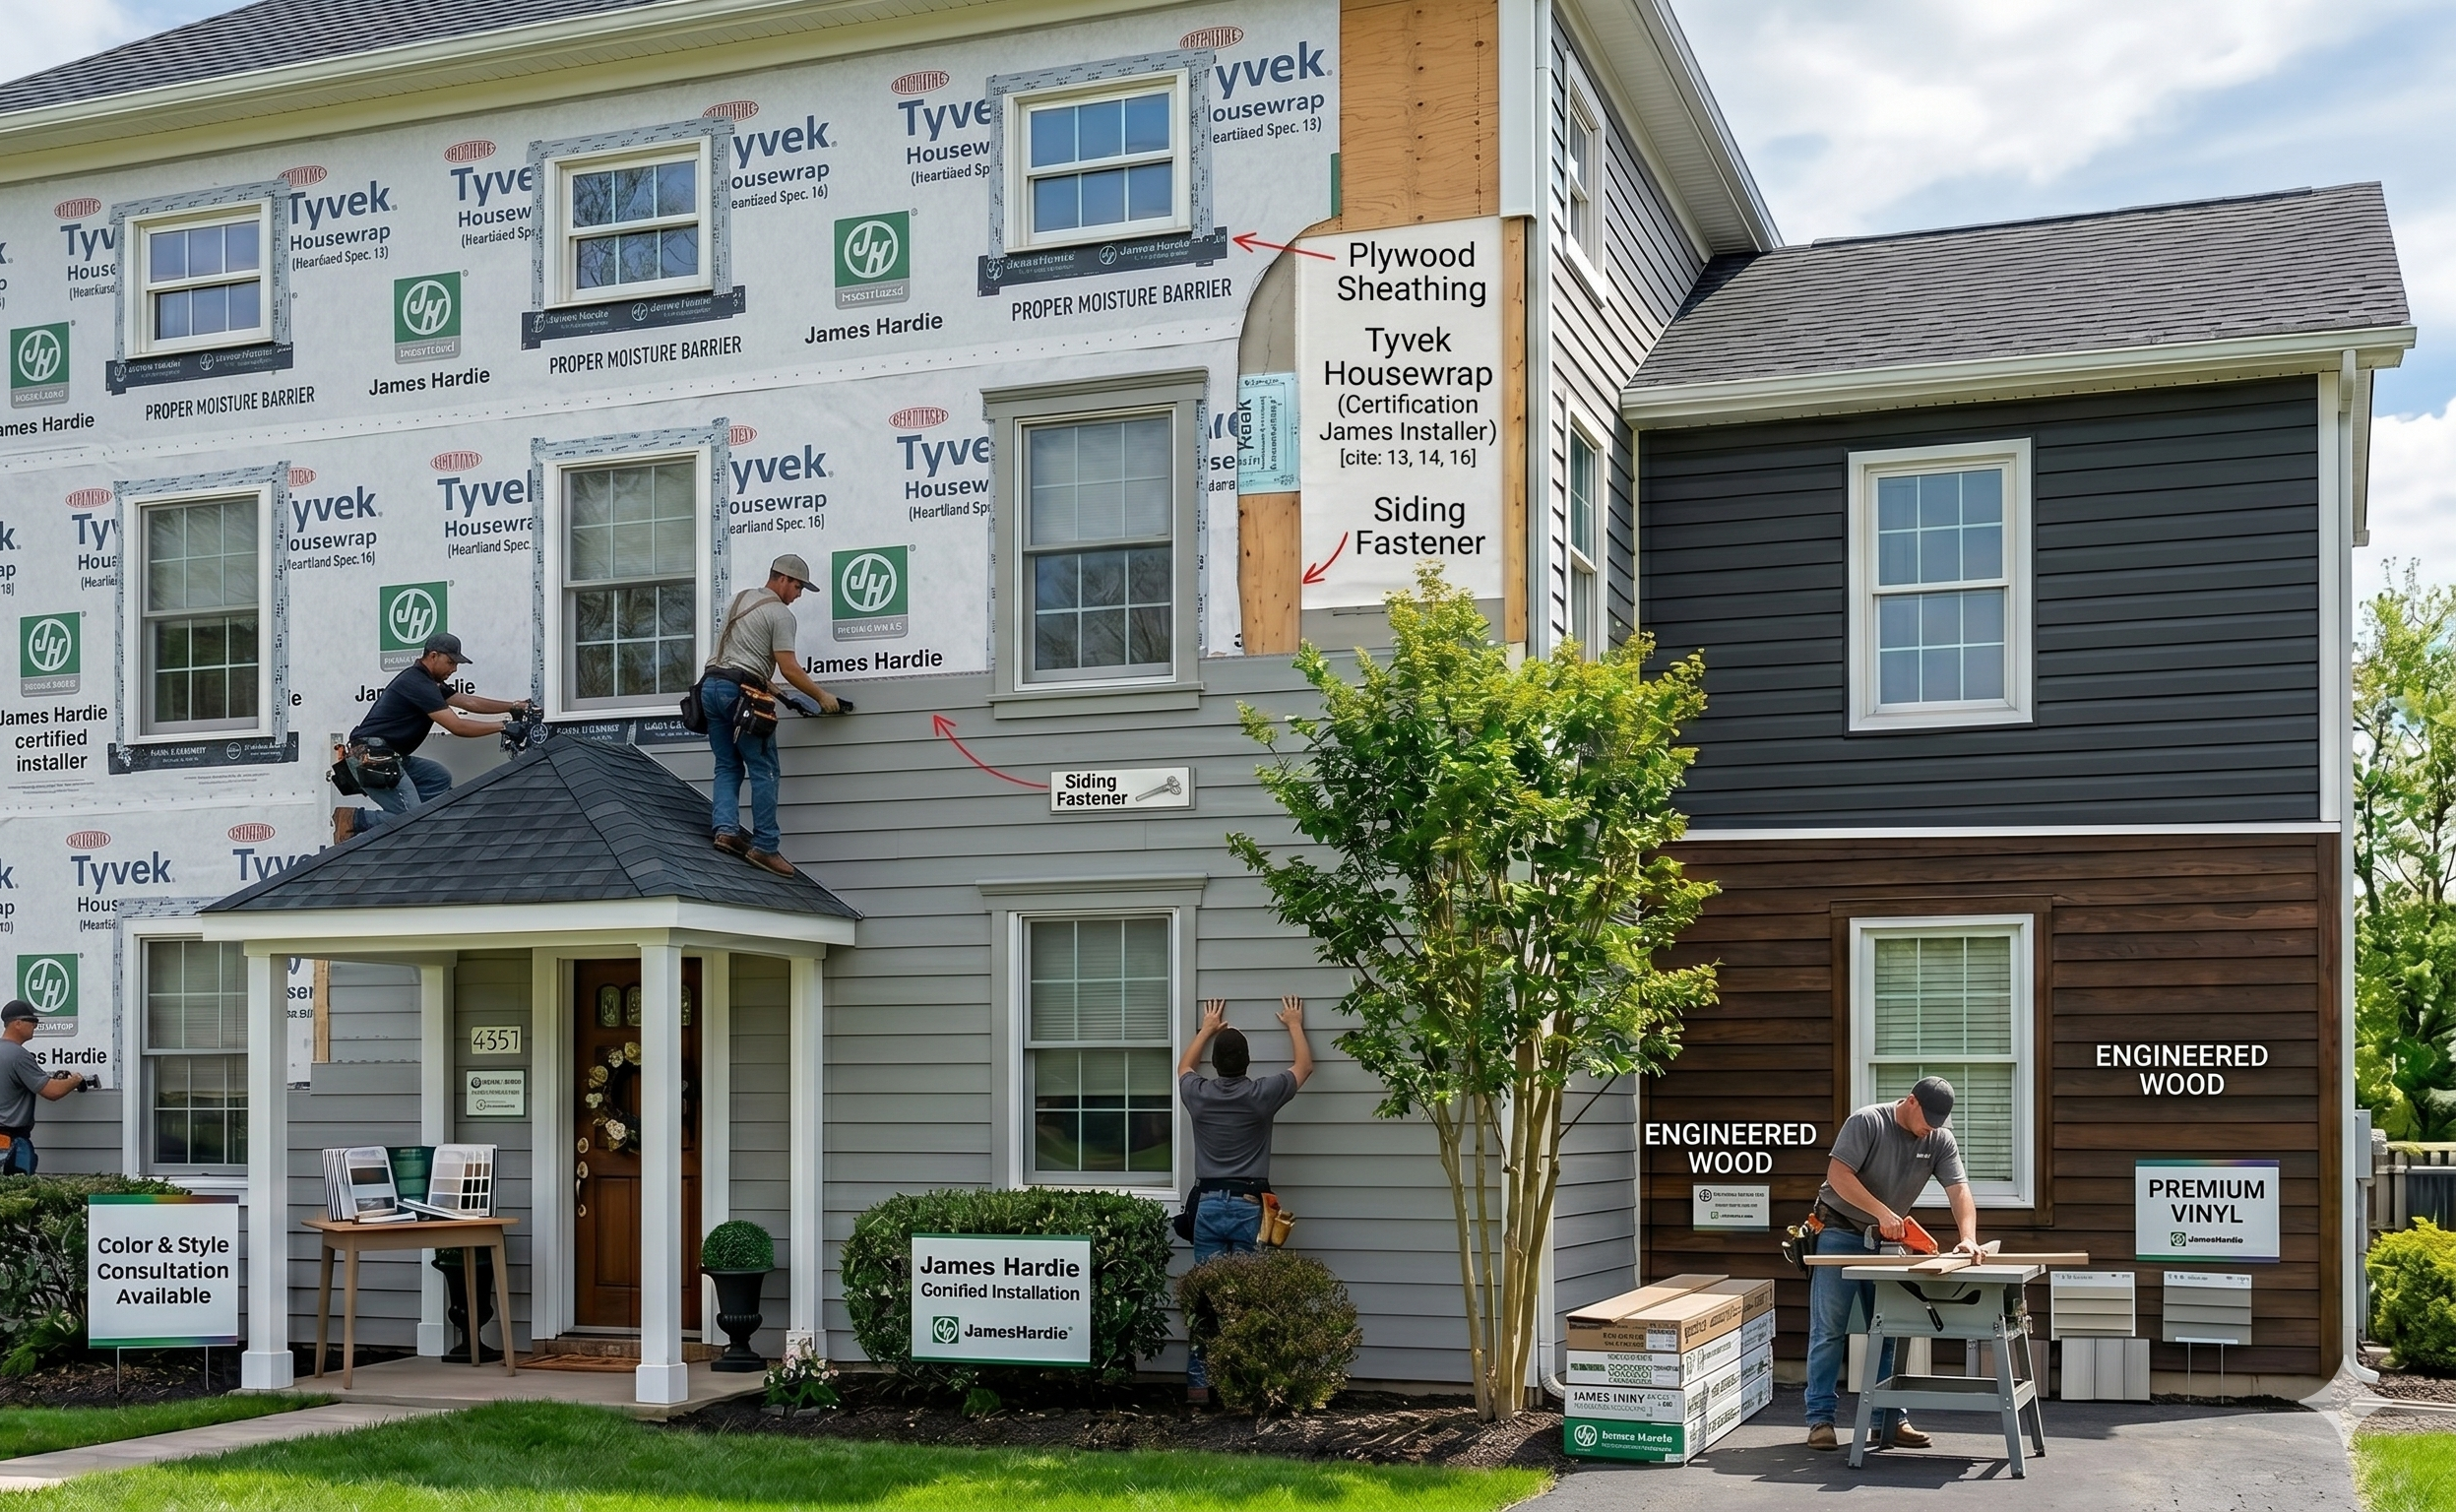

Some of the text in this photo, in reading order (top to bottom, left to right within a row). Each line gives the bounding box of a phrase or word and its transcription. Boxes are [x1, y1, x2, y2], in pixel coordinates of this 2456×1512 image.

[1215, 40, 1326, 100] yvek
[898, 98, 991, 142] Tyve
[1267, 122, 1299, 139] Spec.
[1302, 116, 1322, 133] 13)
[732, 114, 830, 169] yvek
[907, 140, 990, 165] Housew
[450, 165, 533, 208] Tyve
[730, 163, 830, 190] ousewrap
[288, 180, 391, 231] Tyvek
[780, 189, 809, 206] Spec.
[812, 183, 828, 200] 16)
[458, 205, 532, 228] Housew
[60, 223, 115, 262] Tyv
[290, 225, 391, 252] Housewrap
[345, 249, 371, 266] Spec.
[373, 245, 389, 261] 13)
[1349, 240, 1476, 274] Plywood
[67, 263, 116, 282] House
[1012, 278, 1232, 322] PROPER MOISTURE BARRIER
[1337, 275, 1486, 308] Sheathing
[804, 312, 943, 345] James Hardie
[1364, 326, 1452, 359] Tyvek
[549, 335, 742, 375] PROPER MOISTURE BARRIER
[368, 367, 490, 396] James Hardie
[1324, 360, 1493, 392] Housewrap
[146, 385, 316, 421] PROPER MOISTURE BARRIER
[1337, 393, 1479, 417] (Certification
[42, 412, 94, 432] Hardie
[1319, 419, 1498, 445] James Installer)
[897, 433, 989, 478] Tyve
[1340, 448, 1477, 469] [cite: 13, 14, 16]
[728, 444, 827, 495] yvek
[906, 478, 989, 500] Housew
[289, 485, 377, 534] yvek
[729, 493, 827, 515] ousewrap
[1373, 495, 1466, 530] Siding
[776, 517, 806, 533] Spec.
[807, 513, 825, 531] 16)
[287, 531, 377, 552] ousewrap
[503, 538, 532, 554] Spec.
[1355, 529, 1486, 556] Fastener
[333, 554, 360, 569] Spec.
[802, 649, 943, 674] James Hardie
[0, 704, 108, 726] James Hardie
[15, 728, 88, 750] certified
[17, 752, 89, 773] installer
[1065, 773, 1117, 791] Siding
[1056, 791, 1128, 806] Fastener
[70, 850, 172, 895] Tyvek
[51, 1046, 107, 1064] Hardie
[2149, 1179, 2265, 1199] PREMIUM
[2171, 1204, 2244, 1224] VINYL
[97, 1235, 229, 1257] Color & Style
[97, 1261, 229, 1280] Consultation
[919, 1255, 1080, 1277] James Hardie
[116, 1287, 212, 1304] Available
[992, 1284, 1080, 1301] Installation
[964, 1324, 1068, 1340] JamesHardie
[1573, 1391, 1610, 1403] JAMES
